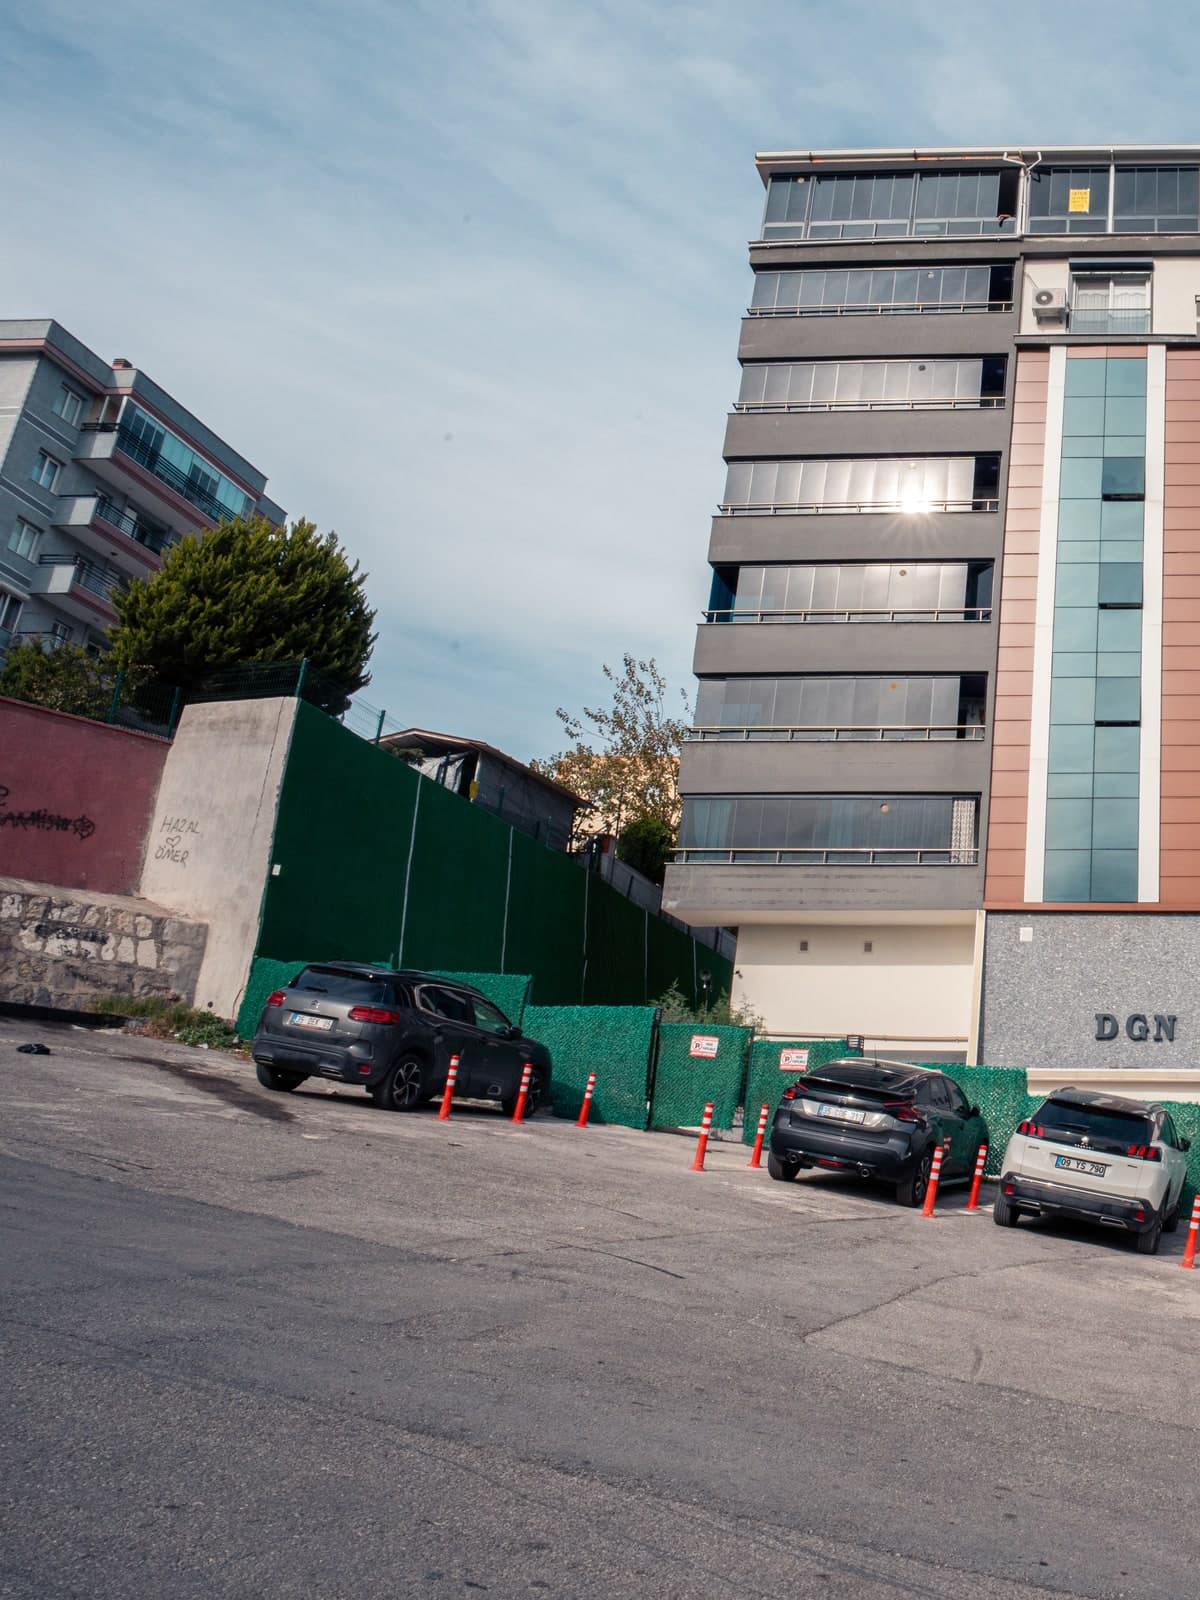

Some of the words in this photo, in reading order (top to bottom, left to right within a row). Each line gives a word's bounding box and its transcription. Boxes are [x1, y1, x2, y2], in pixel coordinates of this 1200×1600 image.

[155, 845, 189, 868] ÖMER
[1095, 1013, 1177, 1042] DGN
[1061, 1159, 1071, 1167] 09
[1076, 1161, 1086, 1170] YS
[1089, 1164, 1104, 1174] 790
